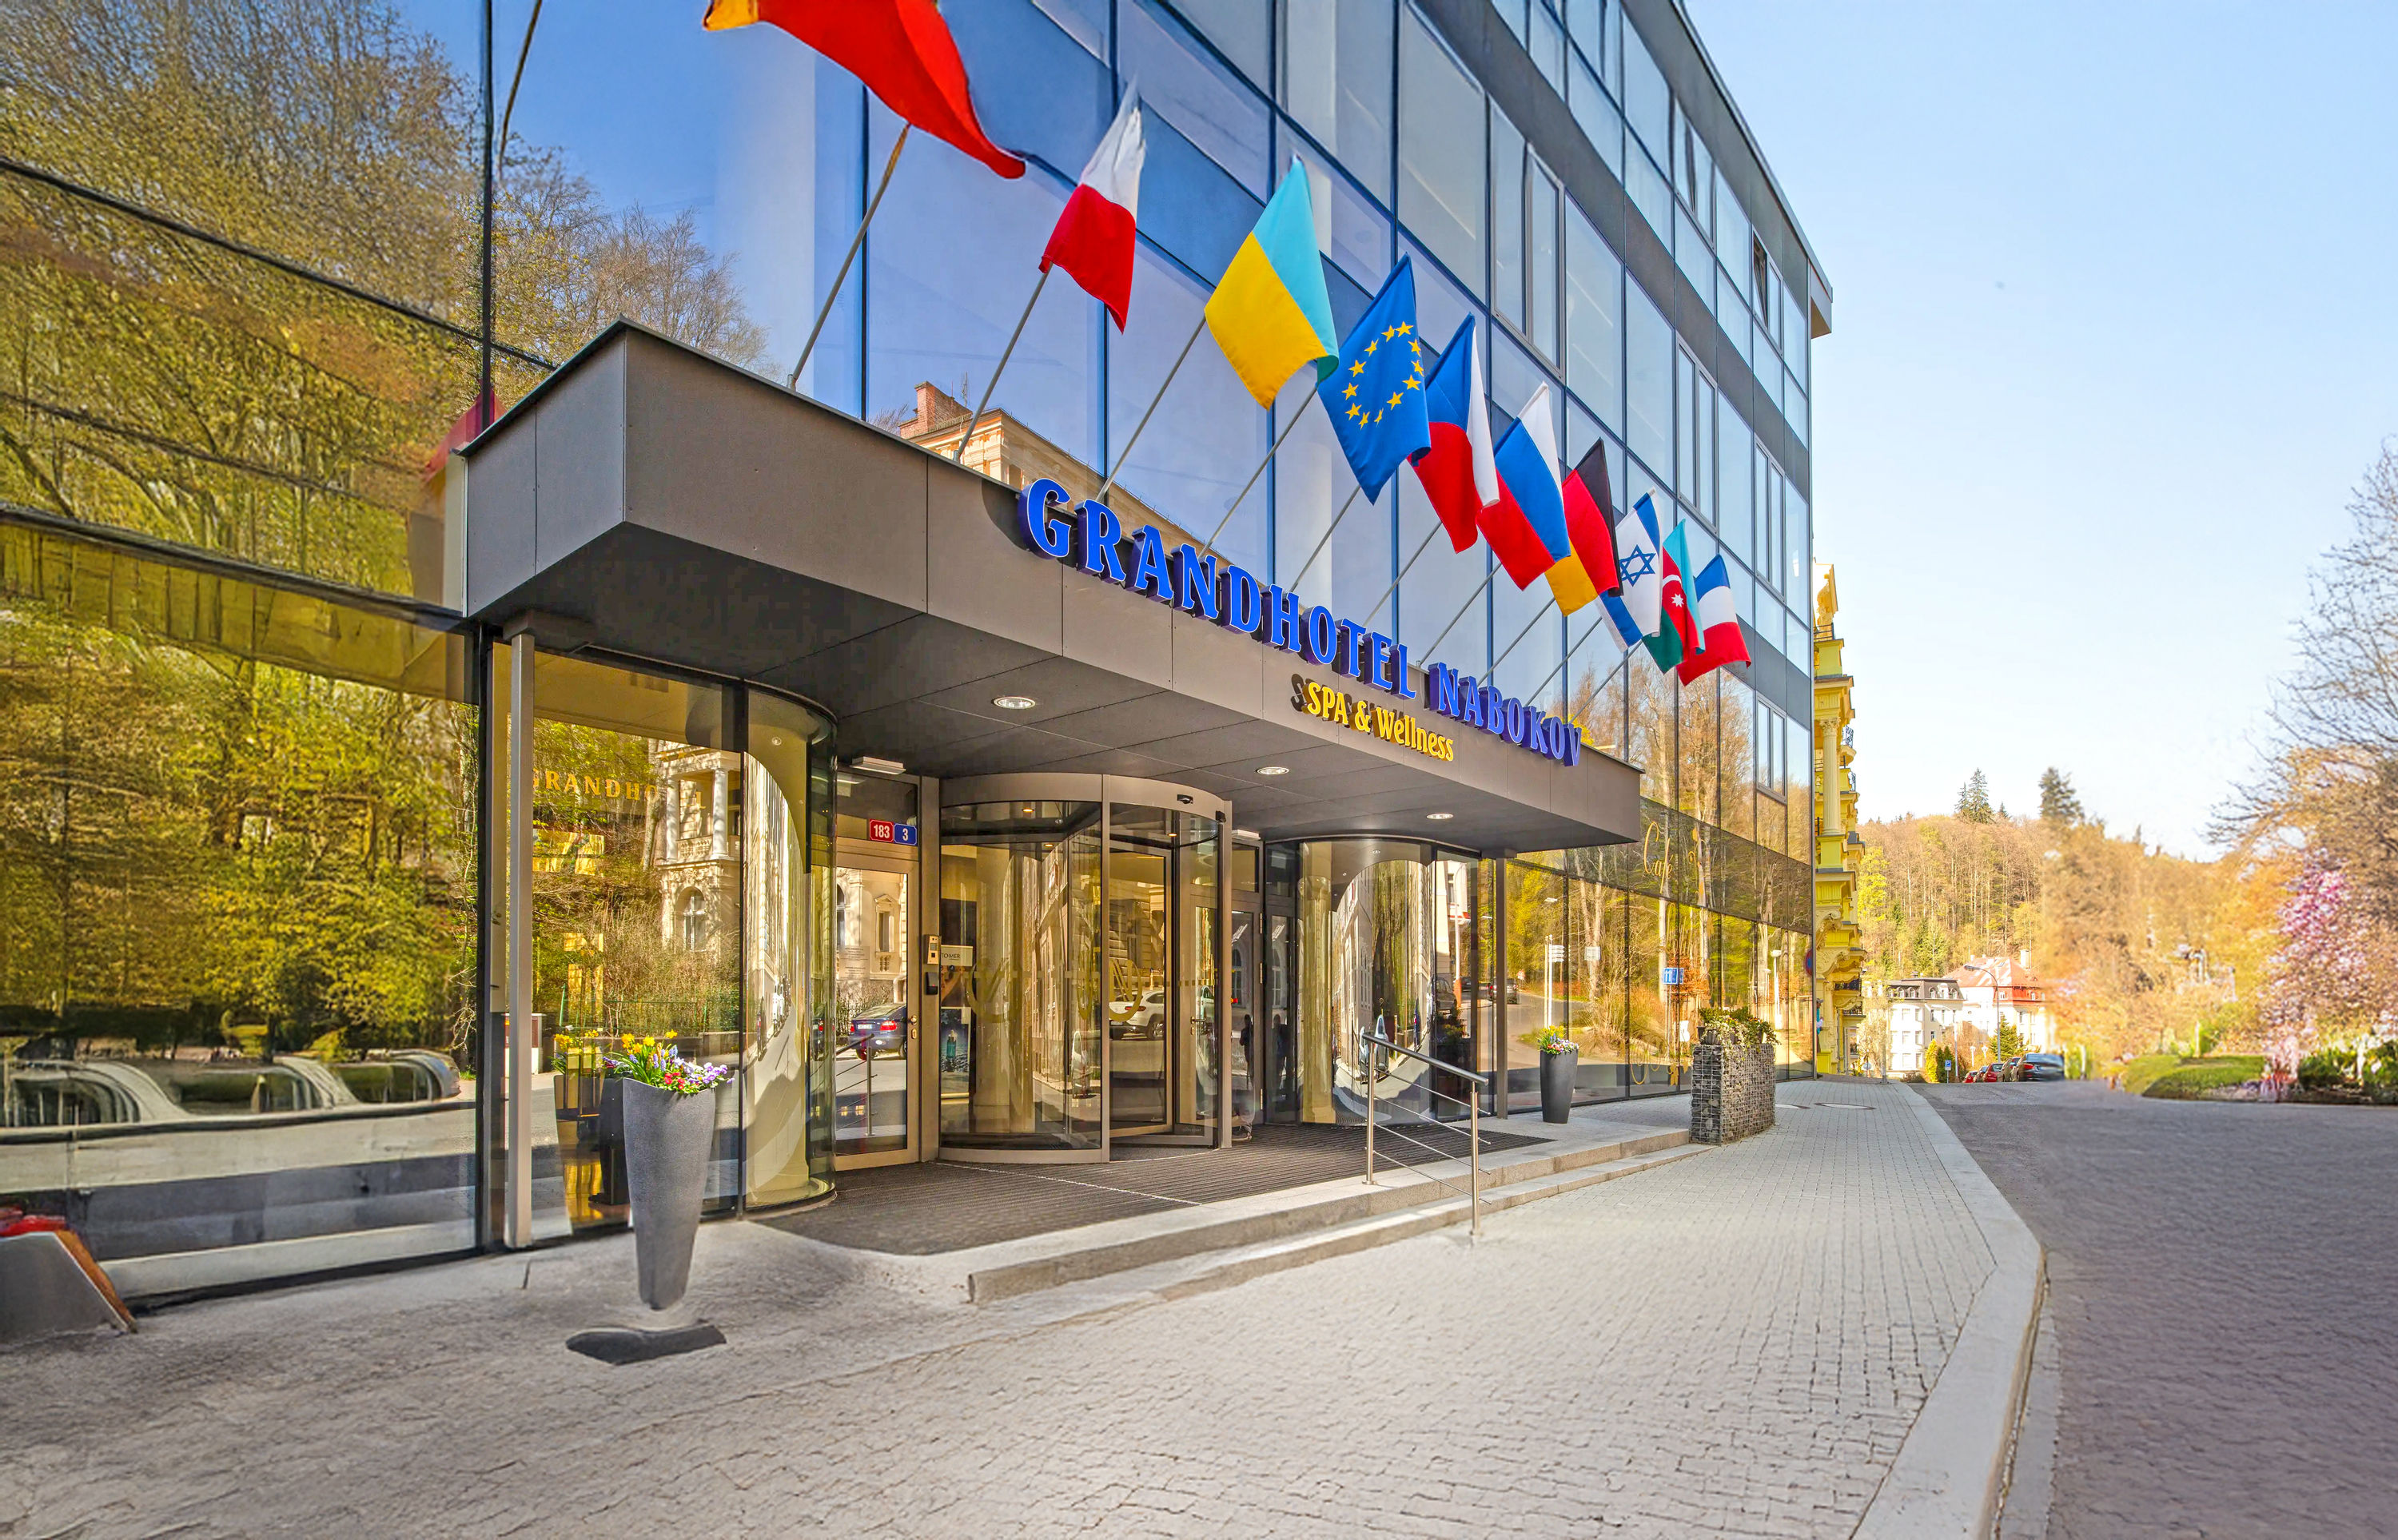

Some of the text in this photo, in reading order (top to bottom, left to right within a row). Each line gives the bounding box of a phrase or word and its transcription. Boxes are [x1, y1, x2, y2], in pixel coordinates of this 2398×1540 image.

[1020, 478, 1583, 767] GRANDHOTEL NABOKOV
[1306, 682, 1454, 762] SPA & Wellness
[873, 824, 890, 839] 183
[902, 827, 909, 842] 3
